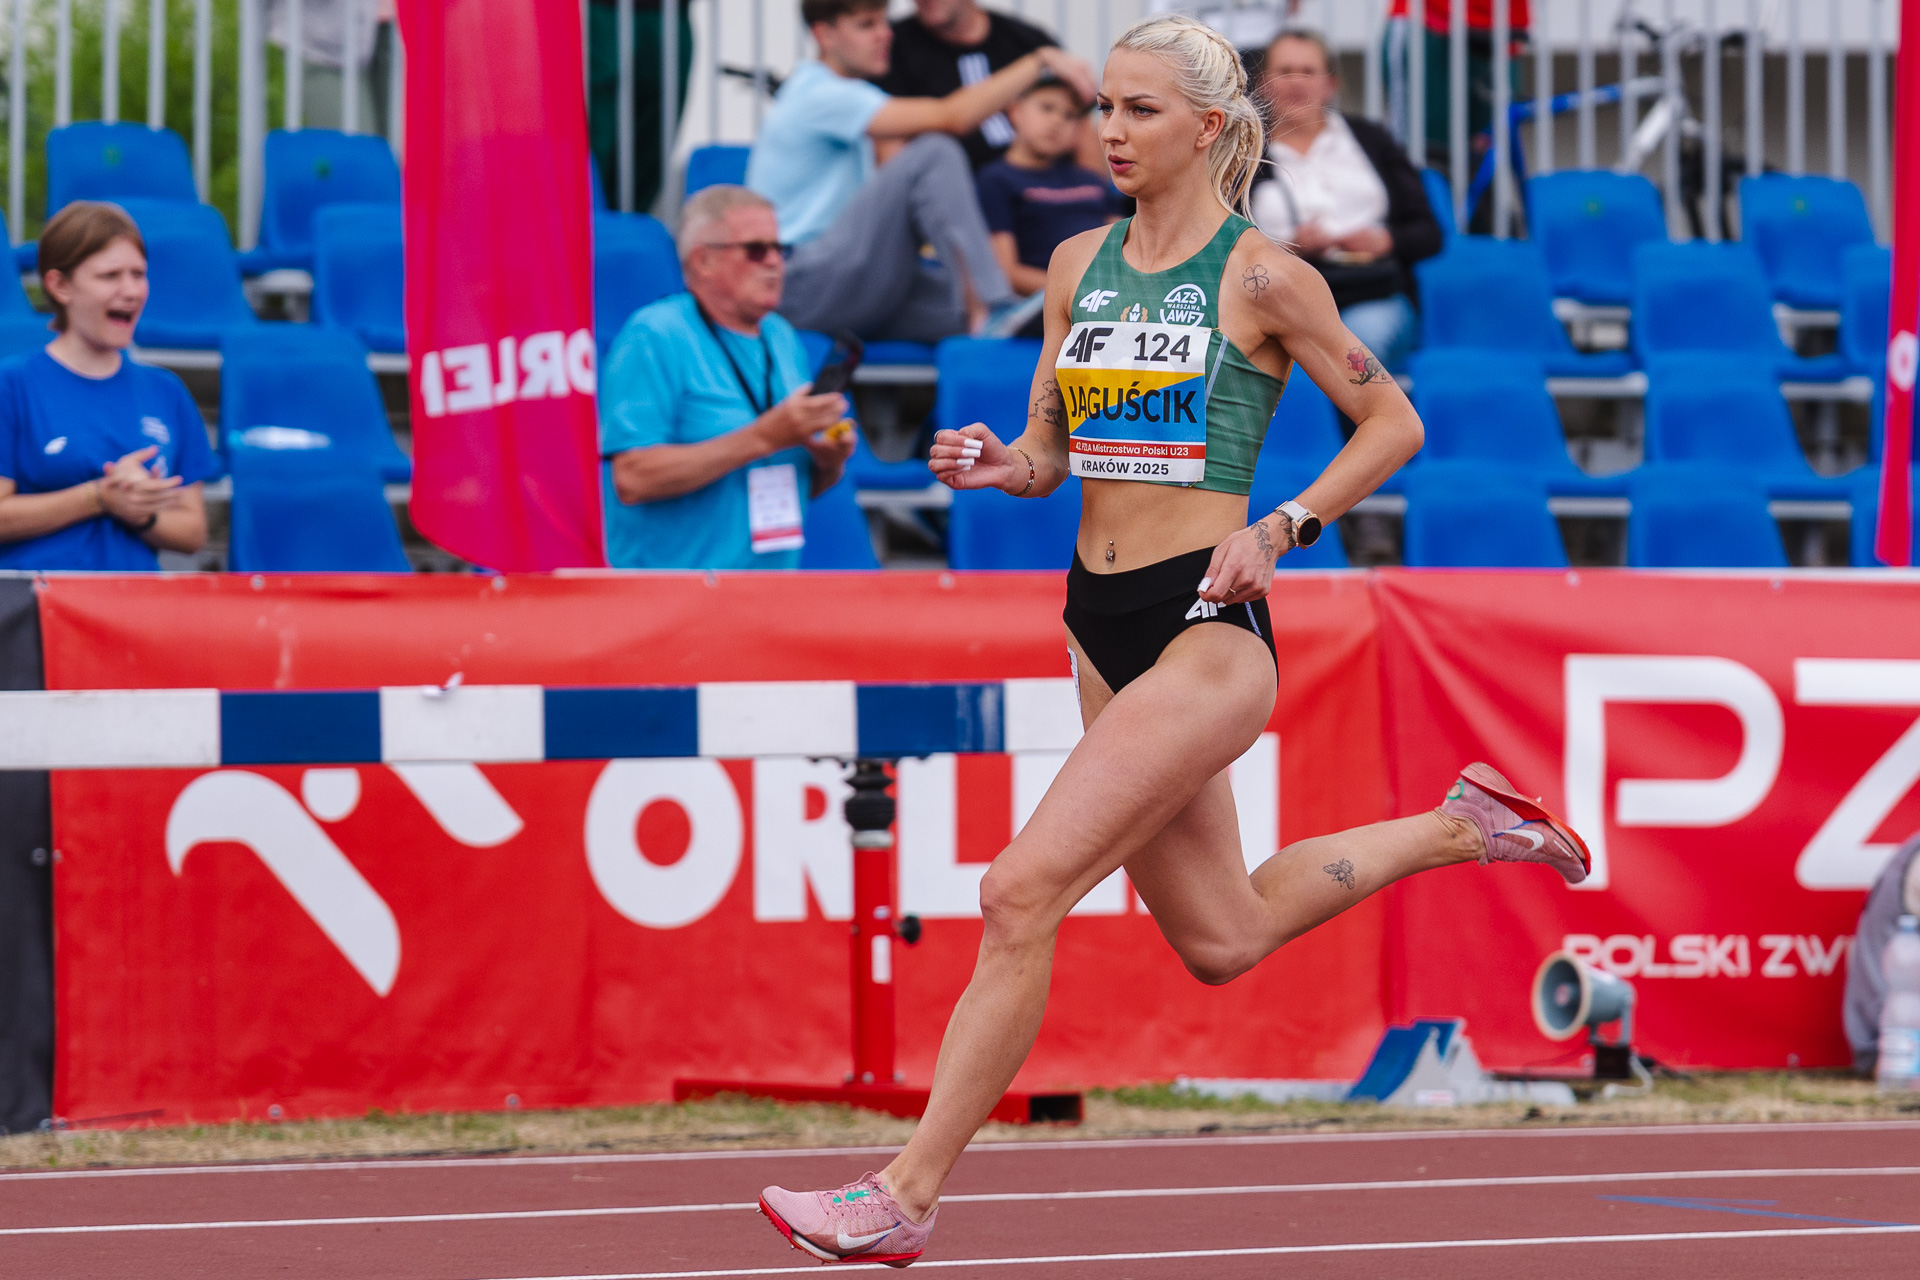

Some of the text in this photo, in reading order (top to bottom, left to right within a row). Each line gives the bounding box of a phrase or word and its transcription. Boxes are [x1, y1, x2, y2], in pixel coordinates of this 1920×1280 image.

[1078, 289, 1119, 312] 4F
[1169, 291, 1199, 304] AZS
[1166, 303, 1200, 311] WARSZAWA
[1166, 309, 1202, 323] AWF
[1065, 327, 1191, 363] 4F 124
[1069, 381, 1198, 424] JAGUŚCIK
[1092, 443, 1140, 454] Mistrzostwa
[1142, 445, 1168, 456] Polski
[1170, 447, 1189, 456] U23
[1081, 458, 1169, 475] KRAKÓW 2025
[1563, 934, 1750, 978] POLSKI
